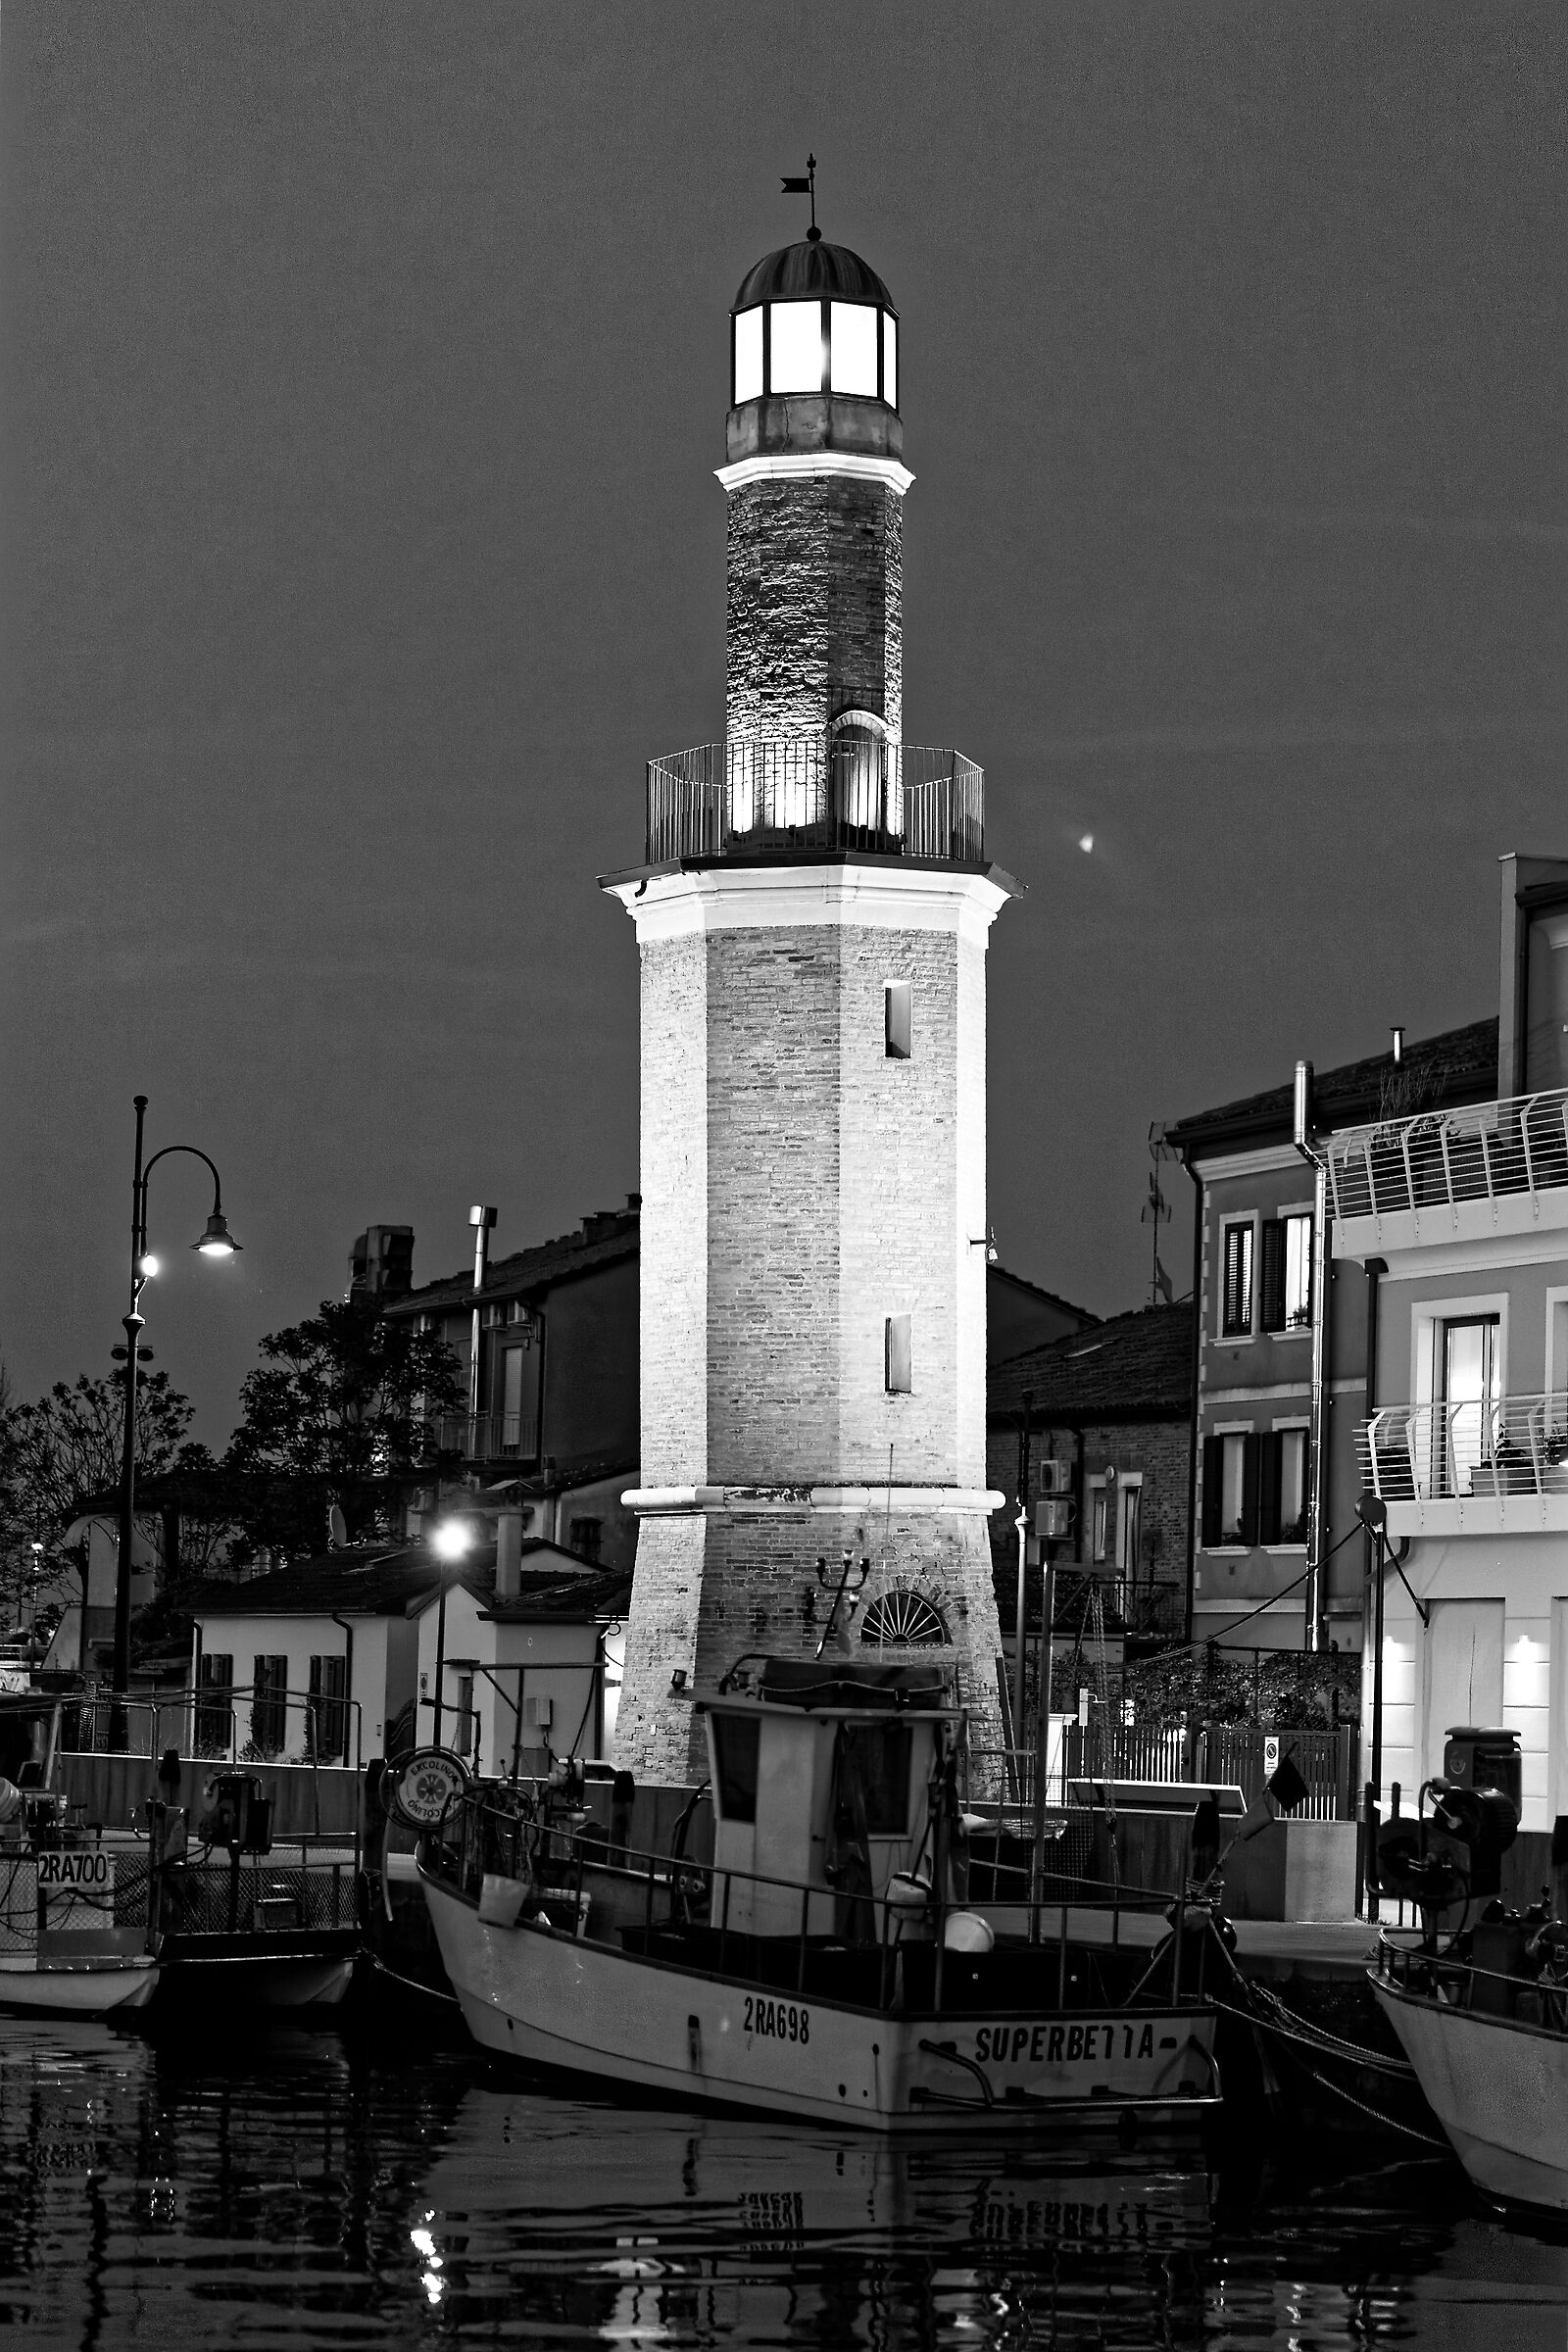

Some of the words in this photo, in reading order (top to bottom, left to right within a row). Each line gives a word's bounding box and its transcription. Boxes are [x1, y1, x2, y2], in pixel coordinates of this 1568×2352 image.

[410, 1760, 456, 1779] ERCOLINO
[407, 1799, 453, 1819] COLINO
[39, 1854, 107, 1884] 2RA700
[744, 1996, 809, 2045] 2RA698
